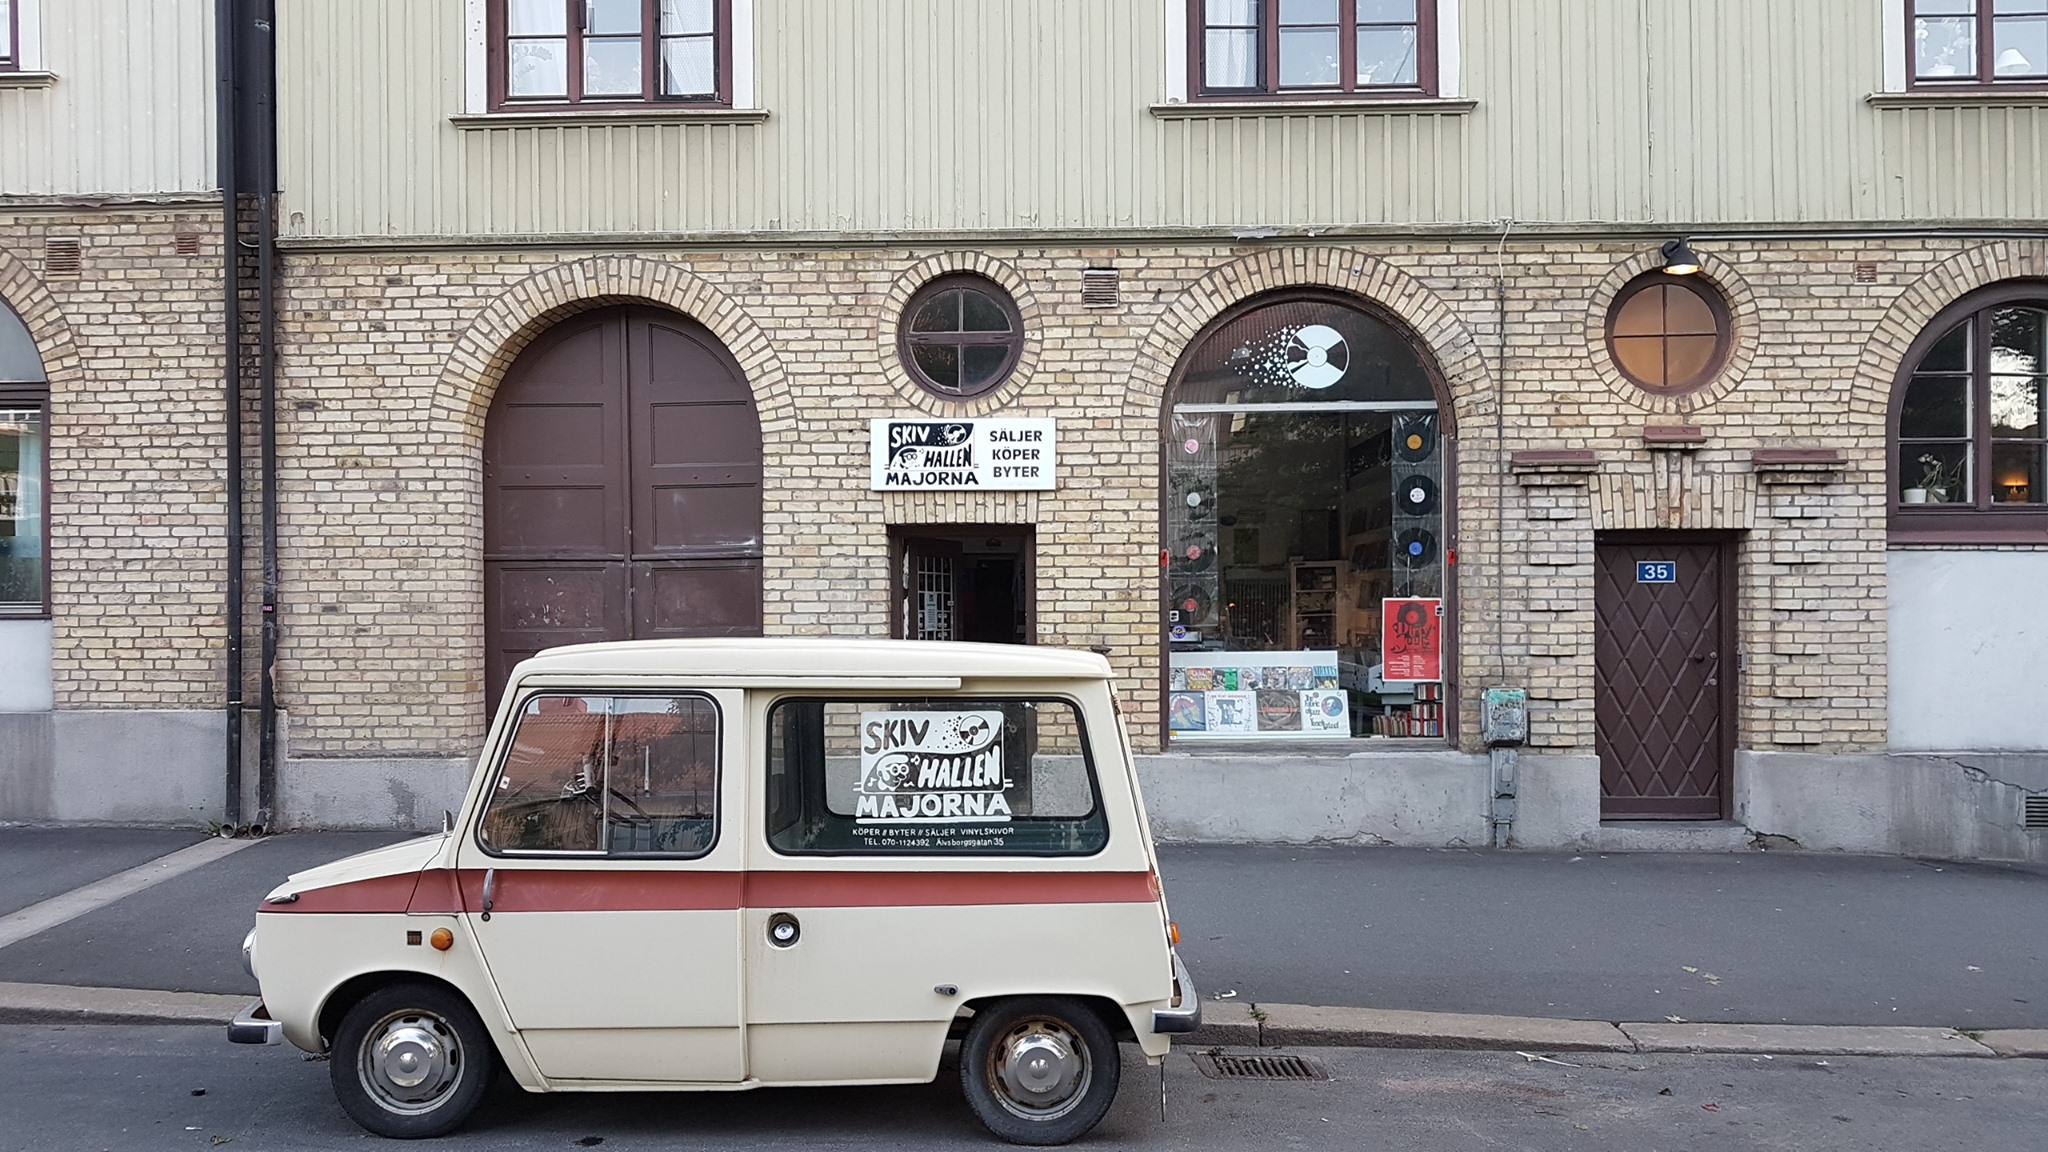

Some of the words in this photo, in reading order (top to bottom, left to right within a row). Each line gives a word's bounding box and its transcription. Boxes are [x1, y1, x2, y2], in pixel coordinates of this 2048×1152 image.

[890, 425, 930, 448] SKIV
[990, 428, 1043, 442] SÄLJER
[923, 444, 972, 468] HALLEN
[992, 446, 1040, 460] KÖPER
[885, 471, 979, 486] MAJORNA
[993, 466, 1039, 478] BYTER
[1644, 564, 1668, 579] 35
[863, 719, 930, 754] SKIV
[918, 745, 1000, 788] HALLEN
[855, 793, 1012, 818] MAJORNA
[852, 827, 880, 836] KÖPER
[889, 828, 916, 836] BYTER
[925, 827, 956, 836] SÄLJER
[960, 827, 1014, 836] VINYLSKIVOR
[993, 837, 1004, 846] 35
